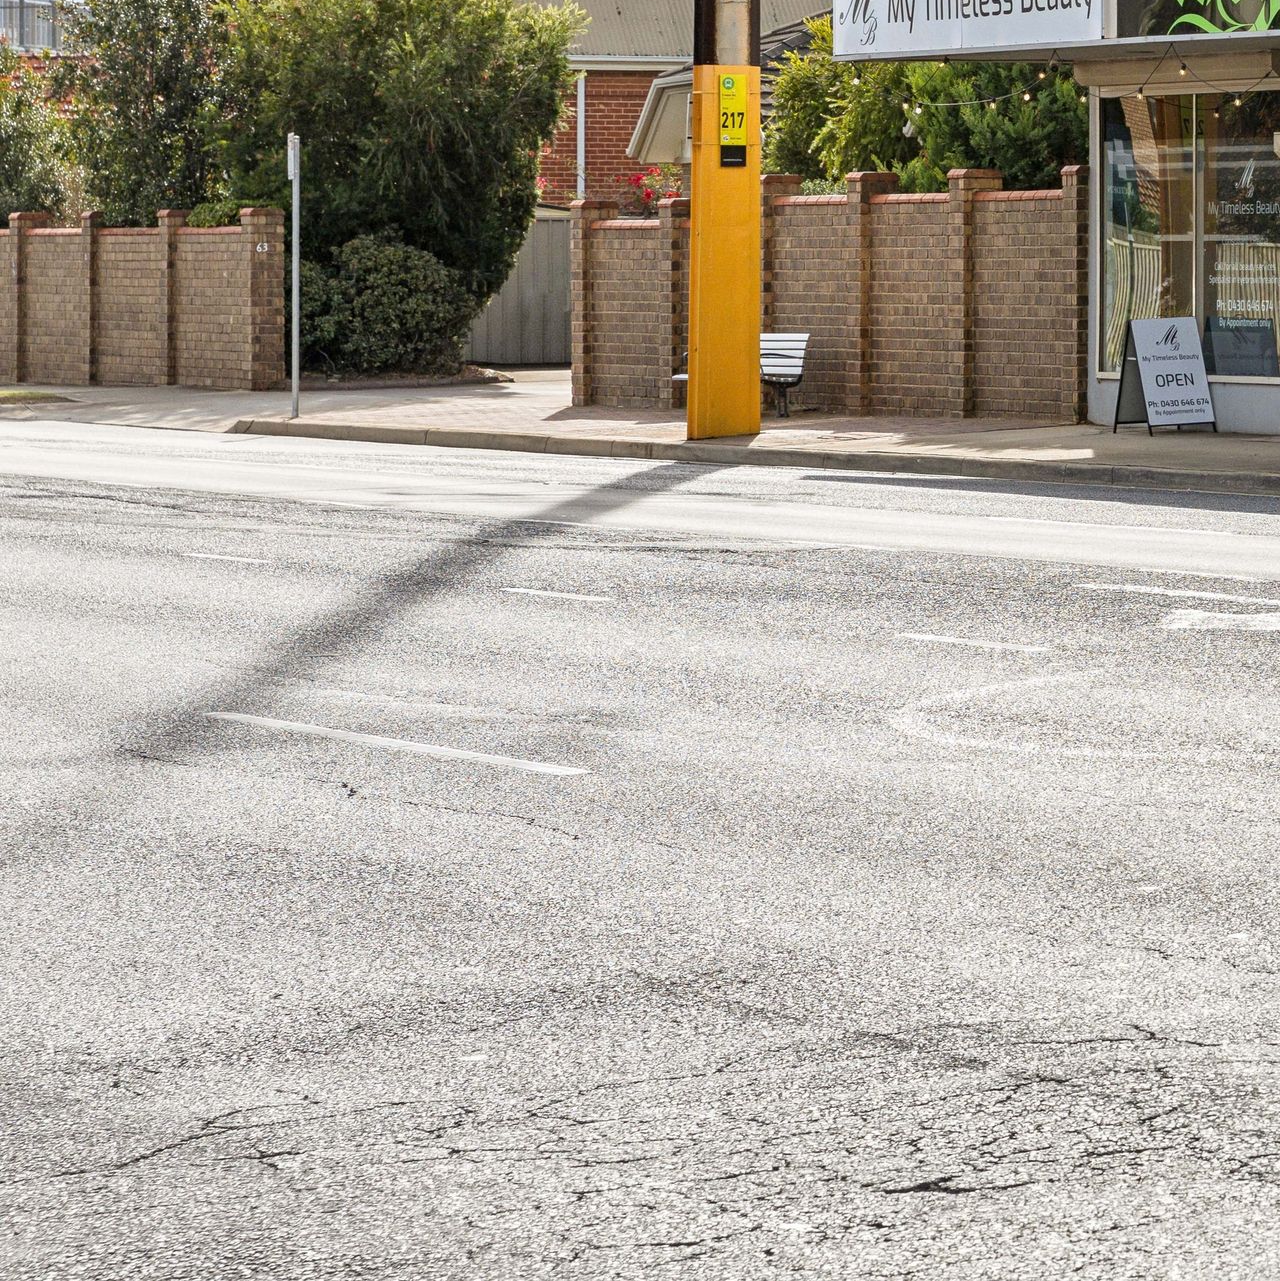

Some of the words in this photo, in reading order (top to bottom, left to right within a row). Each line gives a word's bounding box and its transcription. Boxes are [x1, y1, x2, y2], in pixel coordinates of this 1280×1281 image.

[722, 112, 744, 128] 217
[1207, 202, 1219, 218] My
[1221, 201, 1255, 215] Timeless
[256, 242, 268, 252] 63
[1228, 300, 1246, 311] 0430
[1261, 300, 1273, 311] 674
[1219, 318, 1226, 328] By
[1227, 317, 1258, 328] Appointment
[1259, 318, 1271, 329] only
[1142, 355, 1151, 363] My
[1179, 353, 1200, 361] Beauty
[1155, 373, 1195, 388] OPEN
[1148, 400, 1159, 408] Ph:
[1160, 400, 1179, 408] 0430
[1180, 399, 1195, 407] 646
[1196, 398, 1209, 406] 674
[1163, 408, 1193, 416] Appointment
